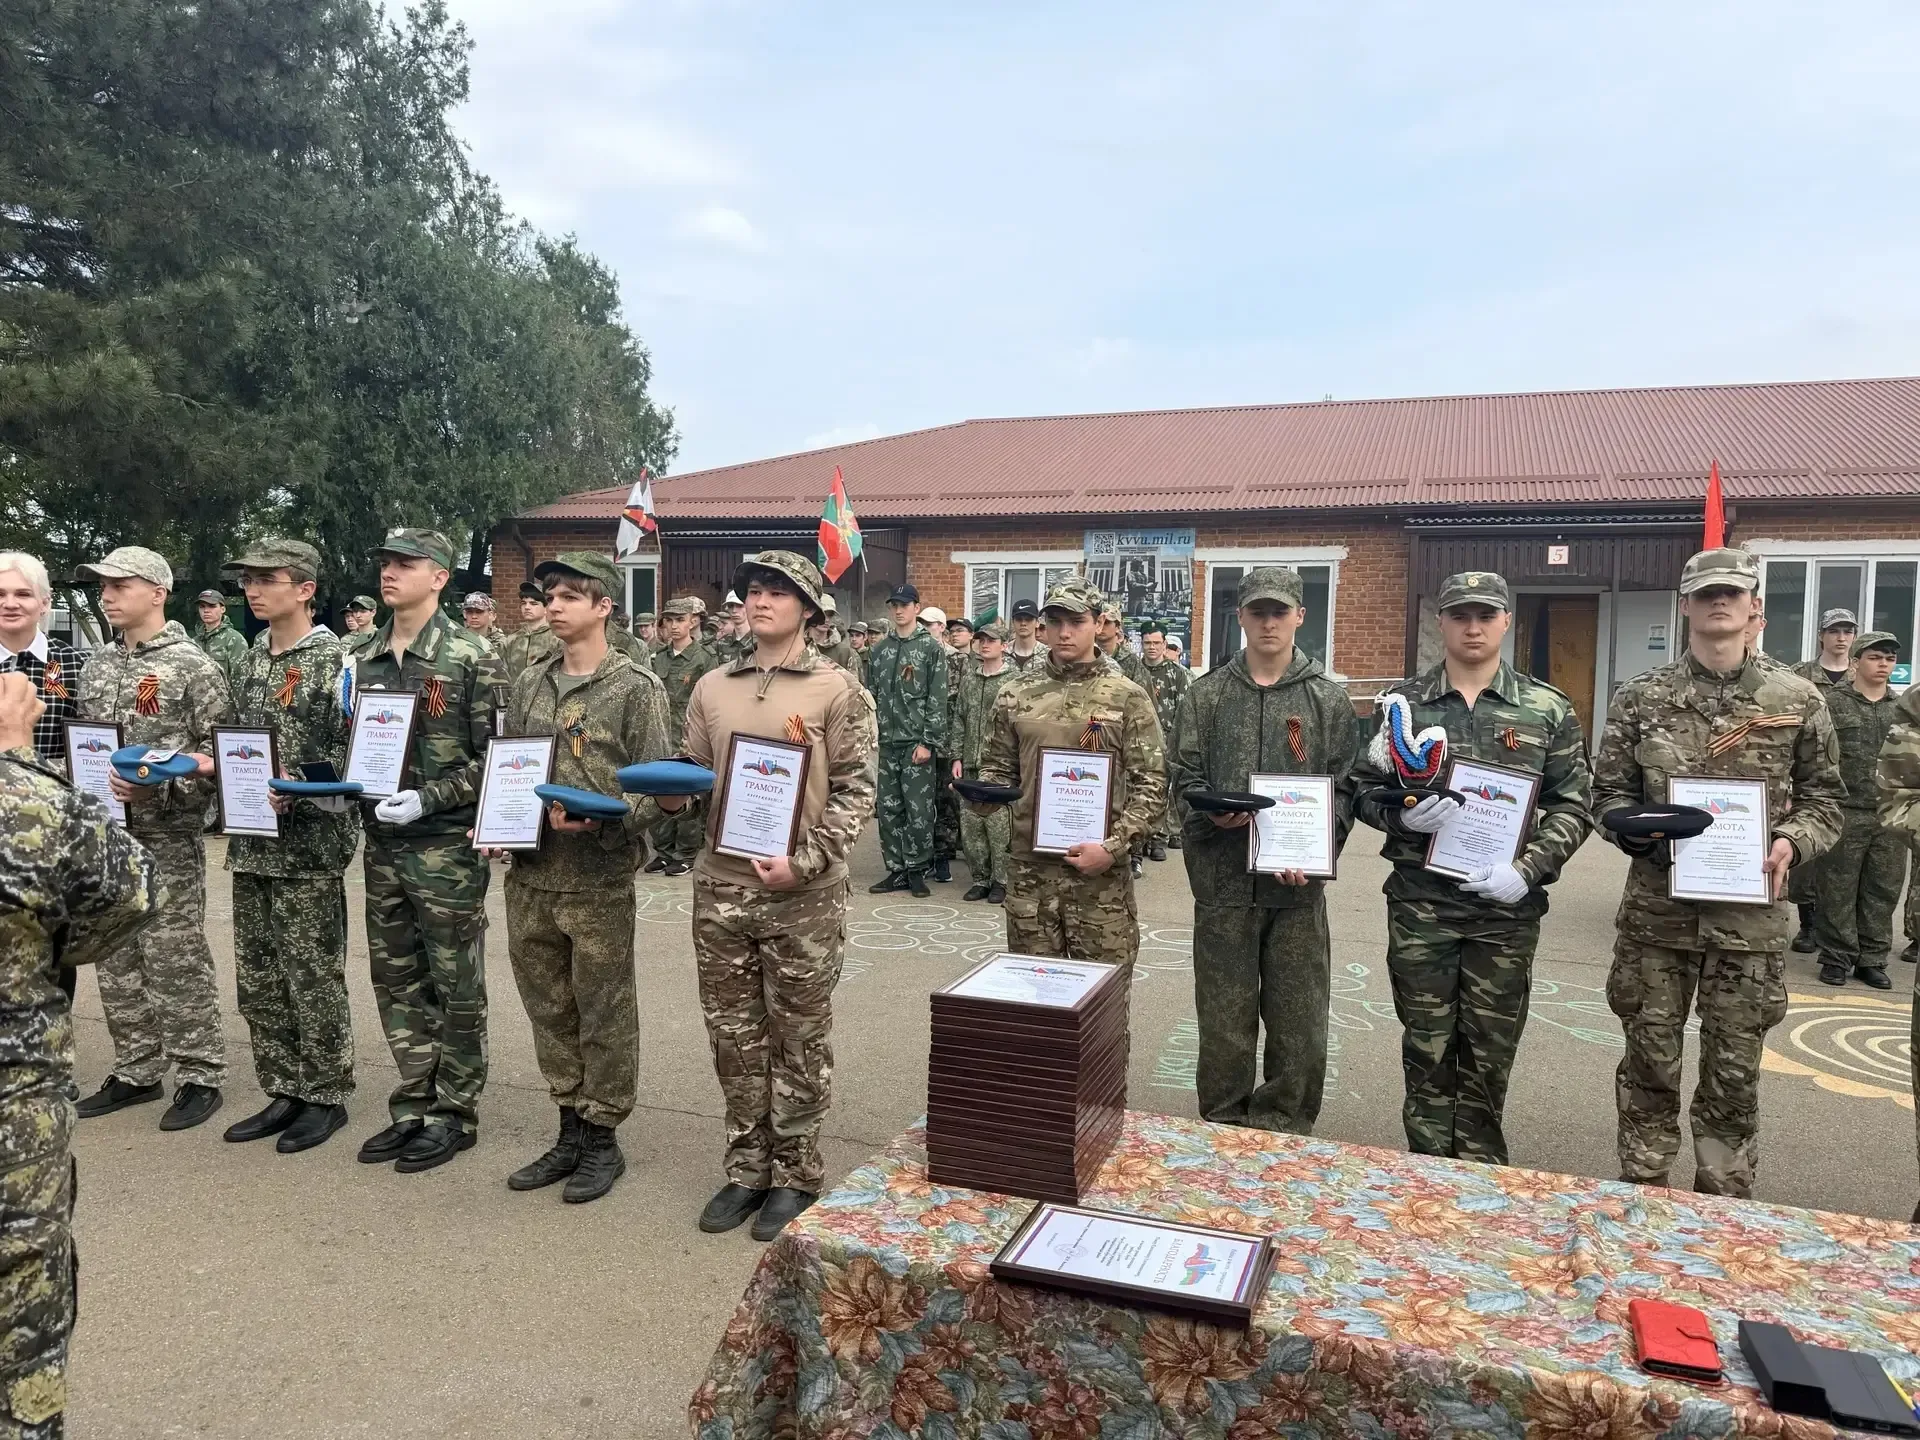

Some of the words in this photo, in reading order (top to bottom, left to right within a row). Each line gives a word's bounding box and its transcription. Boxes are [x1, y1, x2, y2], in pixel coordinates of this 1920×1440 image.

[1116, 532, 1191, 545] kvvu.mil.ru
[1552, 548, 1564, 562] 5
[366, 731, 398, 739] ГРАМОТА
[82, 758, 110, 767] ГРАМОТА
[231, 766, 263, 775] ГРАМОТА
[500, 777, 535, 785] ГРАМОТА
[744, 780, 784, 795] ГРАМОТА
[1055, 787, 1094, 797] ГРАМОТА
[1270, 810, 1314, 818] ГРАМОТА
[1462, 803, 1509, 821] ГРАМОТА
[1707, 823, 1746, 832] АМОТА
